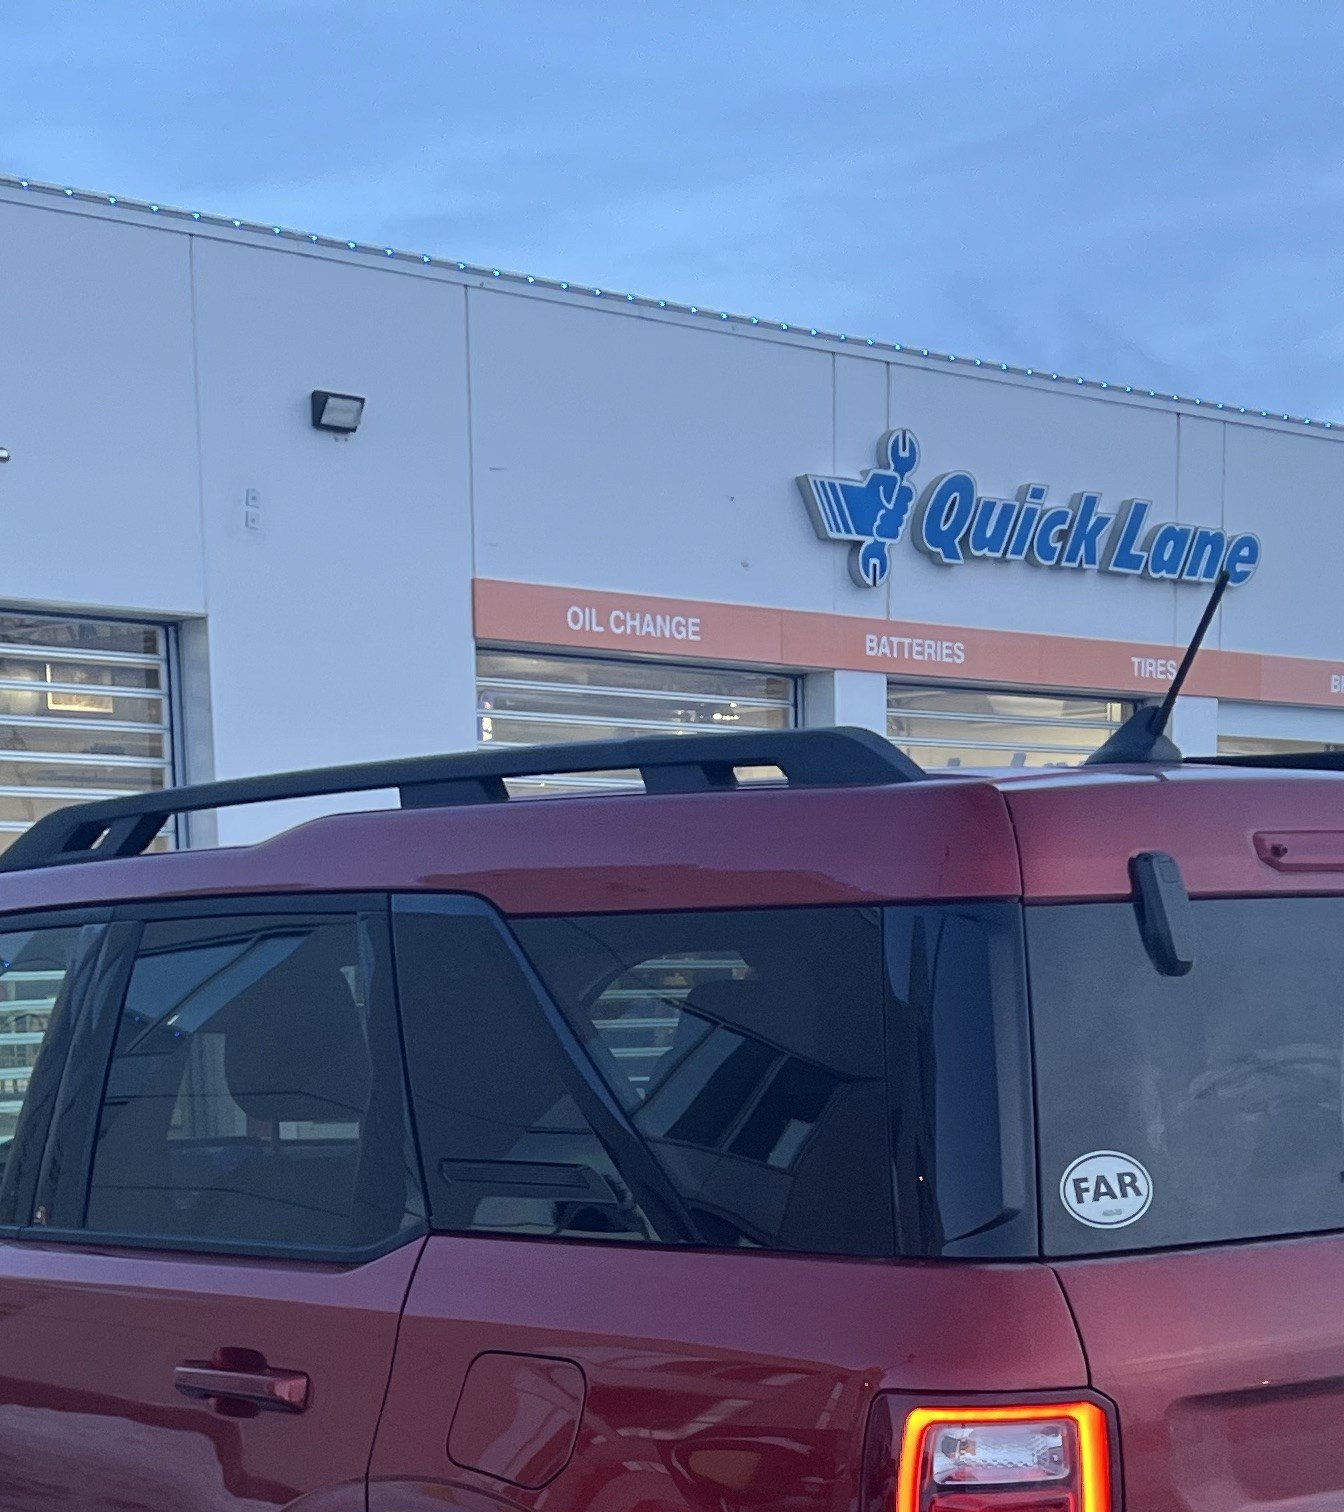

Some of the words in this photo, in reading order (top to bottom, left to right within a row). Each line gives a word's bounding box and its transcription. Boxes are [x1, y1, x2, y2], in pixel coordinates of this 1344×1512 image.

[914, 470, 1116, 569] Quick
[1109, 497, 1262, 587] Lane
[566, 605, 604, 633] OIL
[609, 609, 702, 642] CHANGE
[864, 633, 965, 664] BATTERIES
[1130, 655, 1178, 681] TIRES
[1072, 1171, 1143, 1204] FAR
